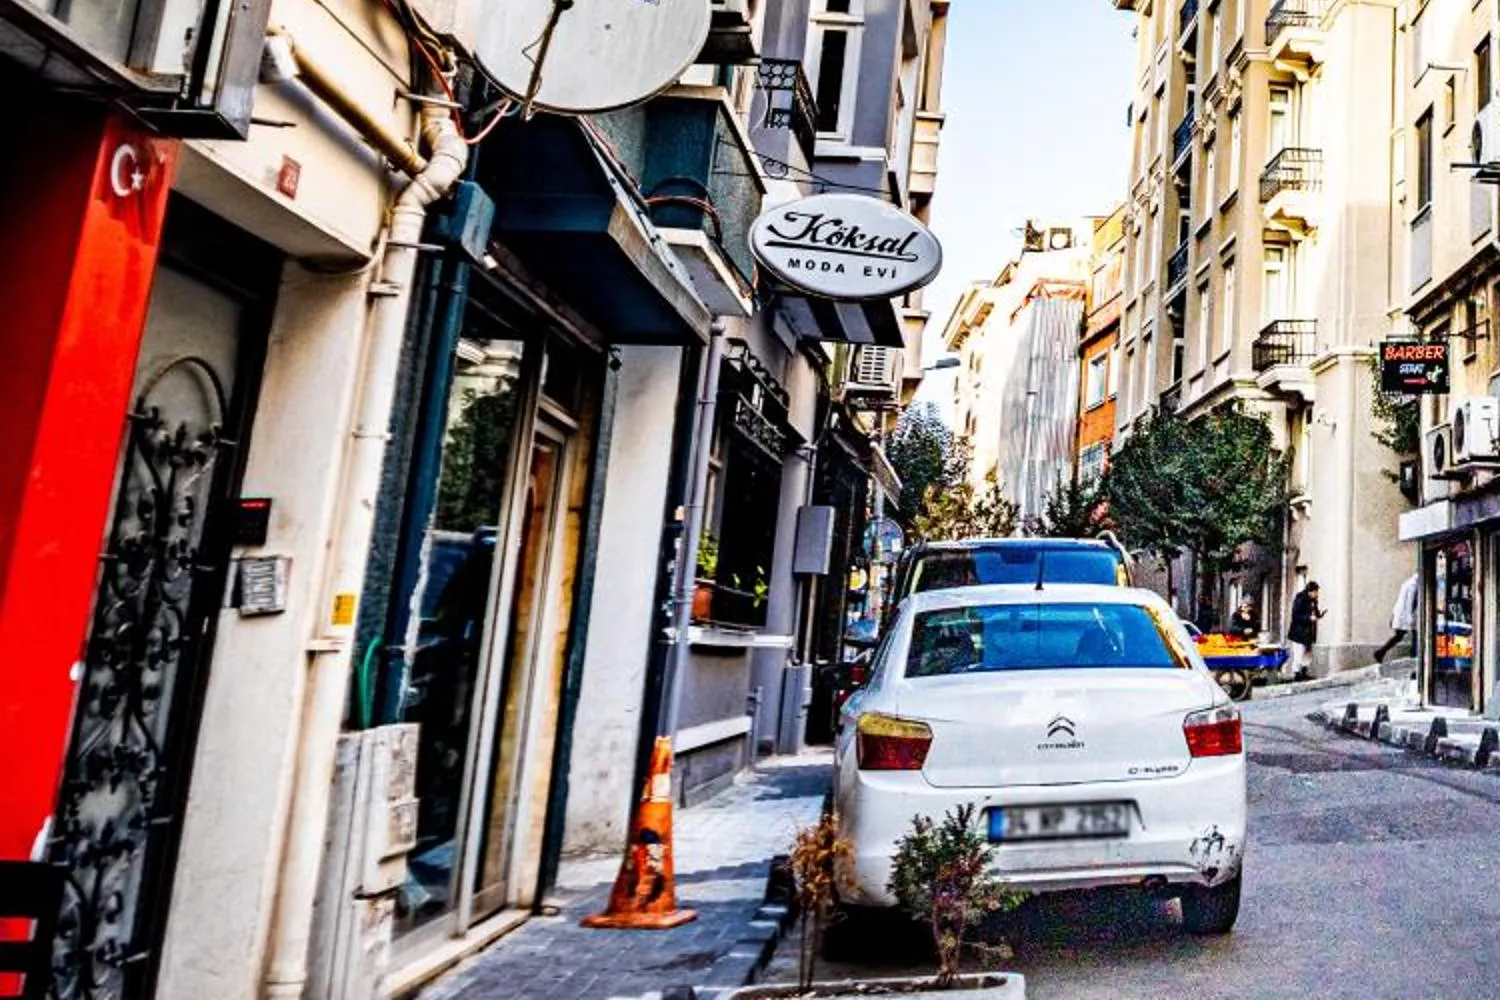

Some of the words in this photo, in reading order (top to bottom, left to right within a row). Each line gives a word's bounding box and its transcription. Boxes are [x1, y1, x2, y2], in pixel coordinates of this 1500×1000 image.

[766, 211, 920, 262] Köksal
[787, 257, 845, 274] MODA
[1385, 344, 1446, 361] BARBER
